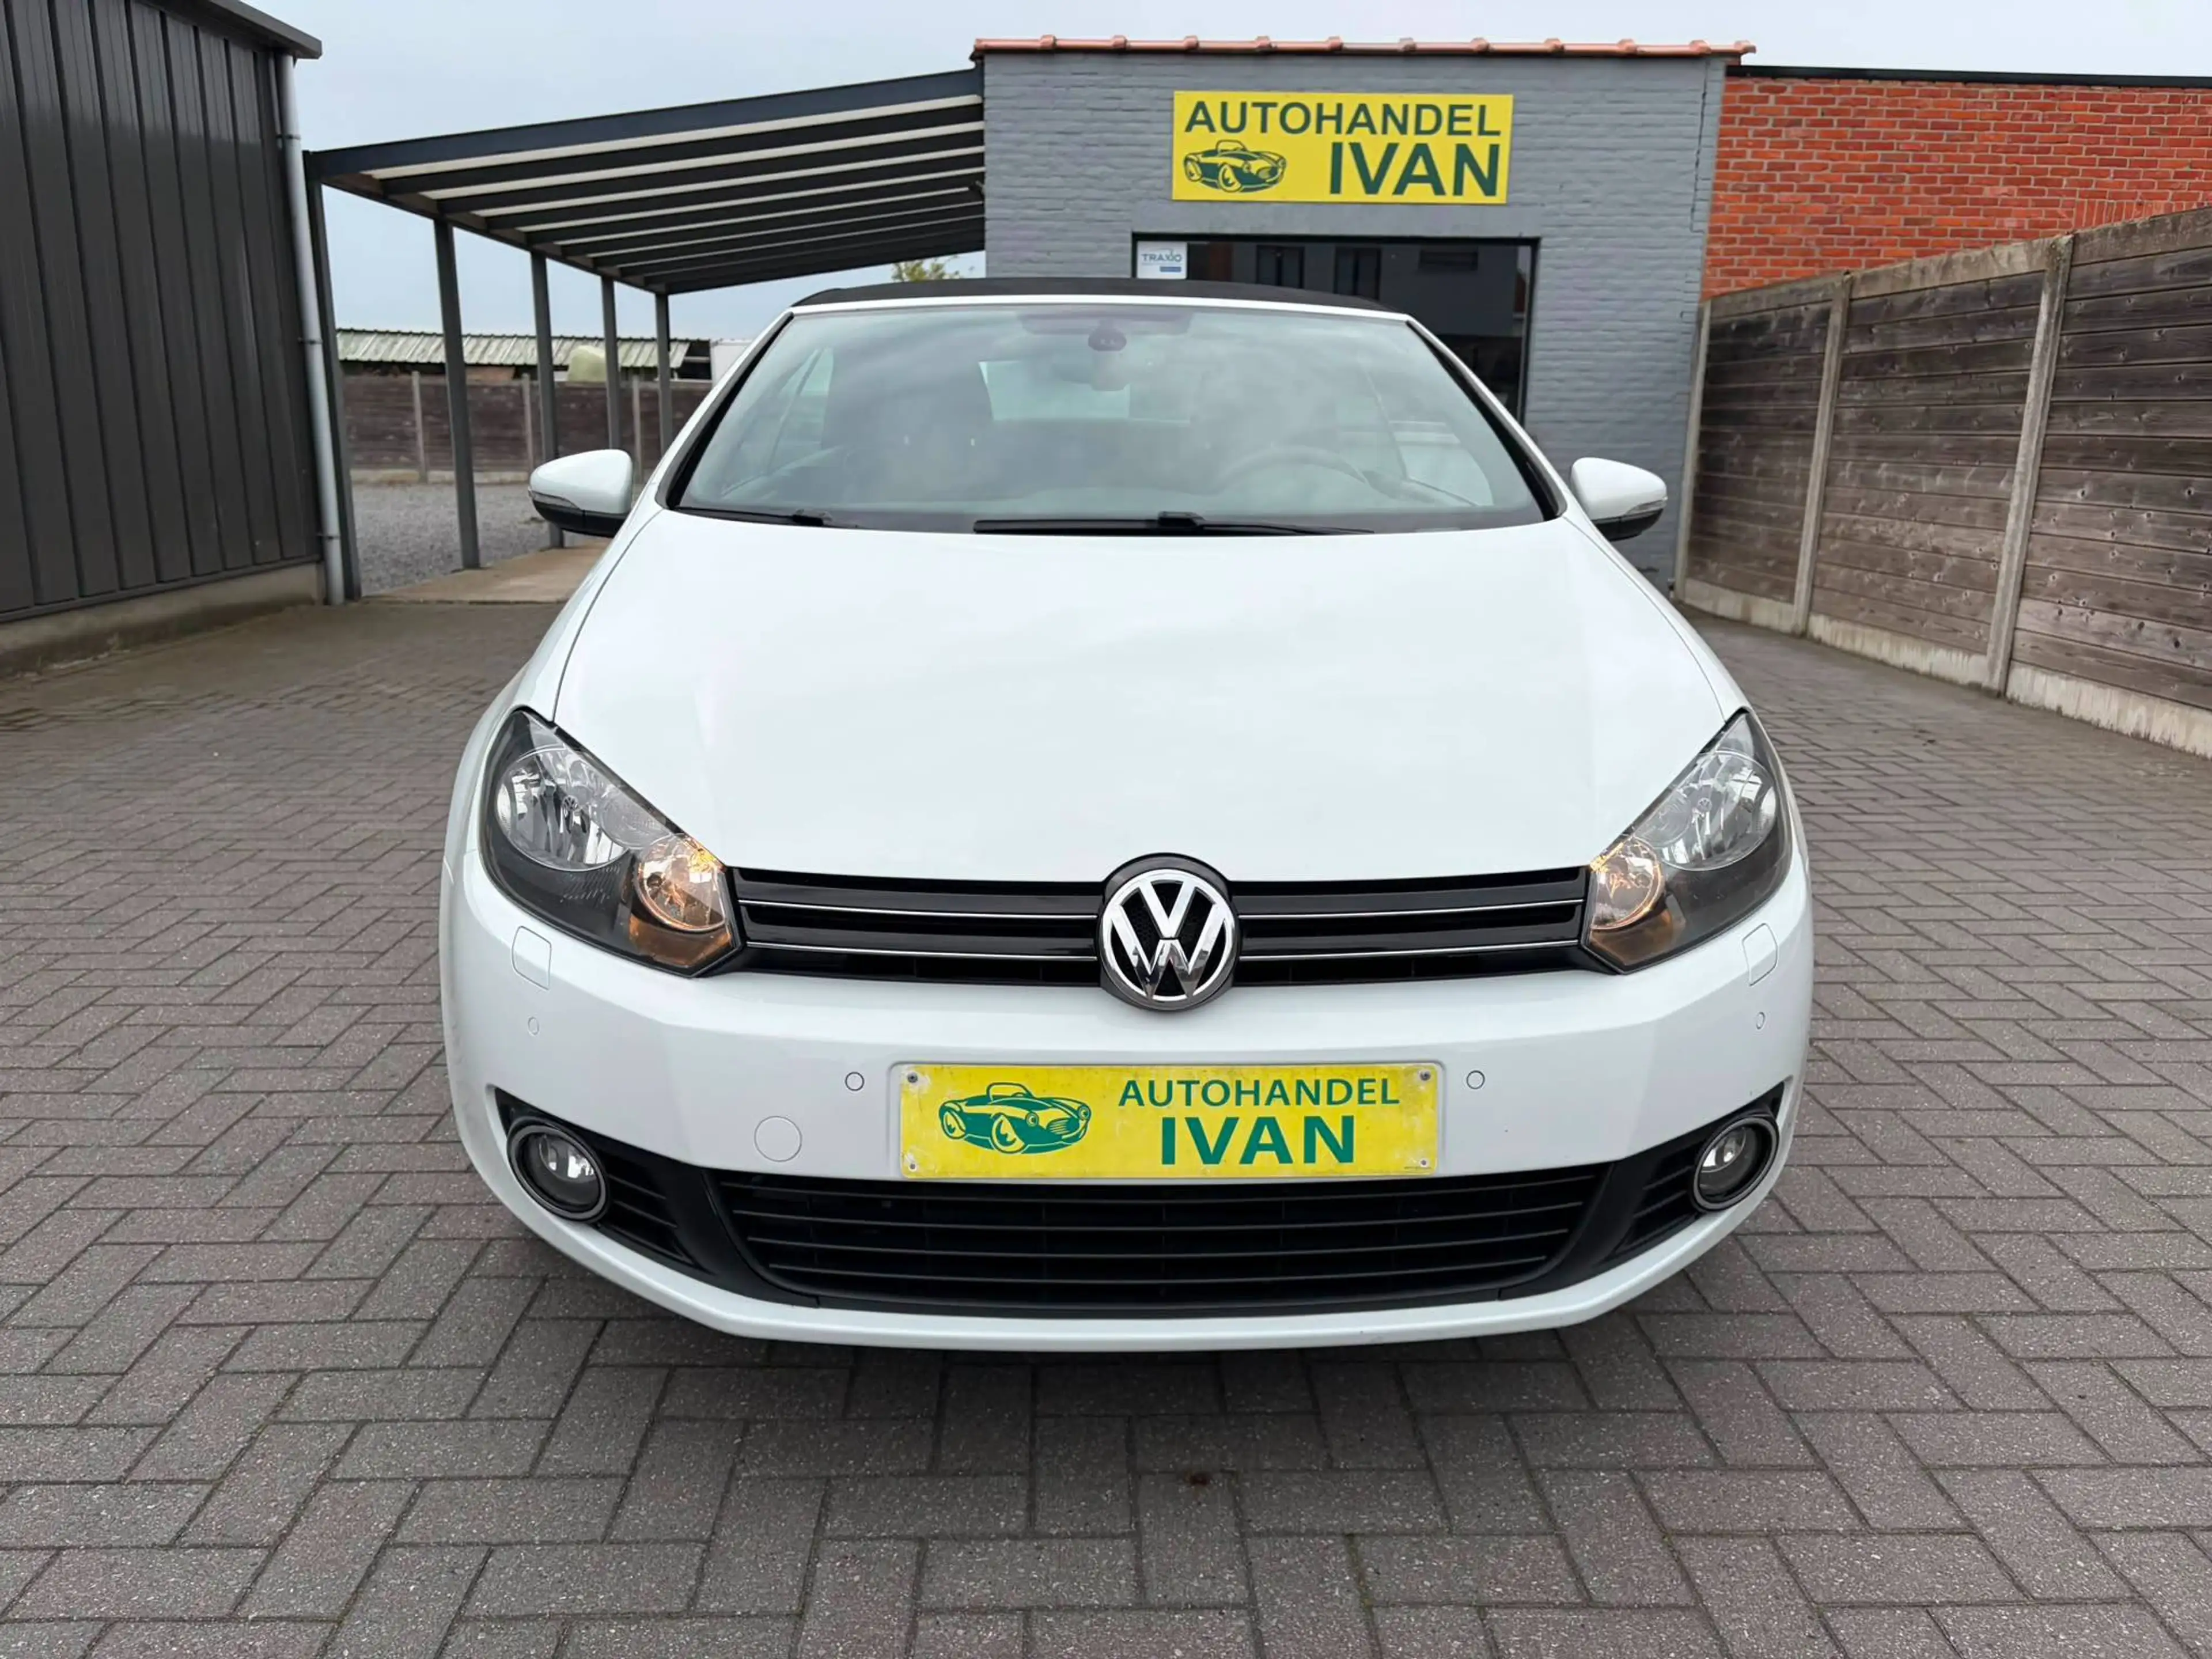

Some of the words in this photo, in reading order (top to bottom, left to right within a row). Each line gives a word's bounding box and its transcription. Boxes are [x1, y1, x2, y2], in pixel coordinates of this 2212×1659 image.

[1184, 100, 1501, 137] AUTOHANDEL
[1330, 142, 1501, 197] IVAN
[1118, 1078, 1400, 1107] AUTOHANDEL
[1161, 1115, 1355, 1165] IVAN
